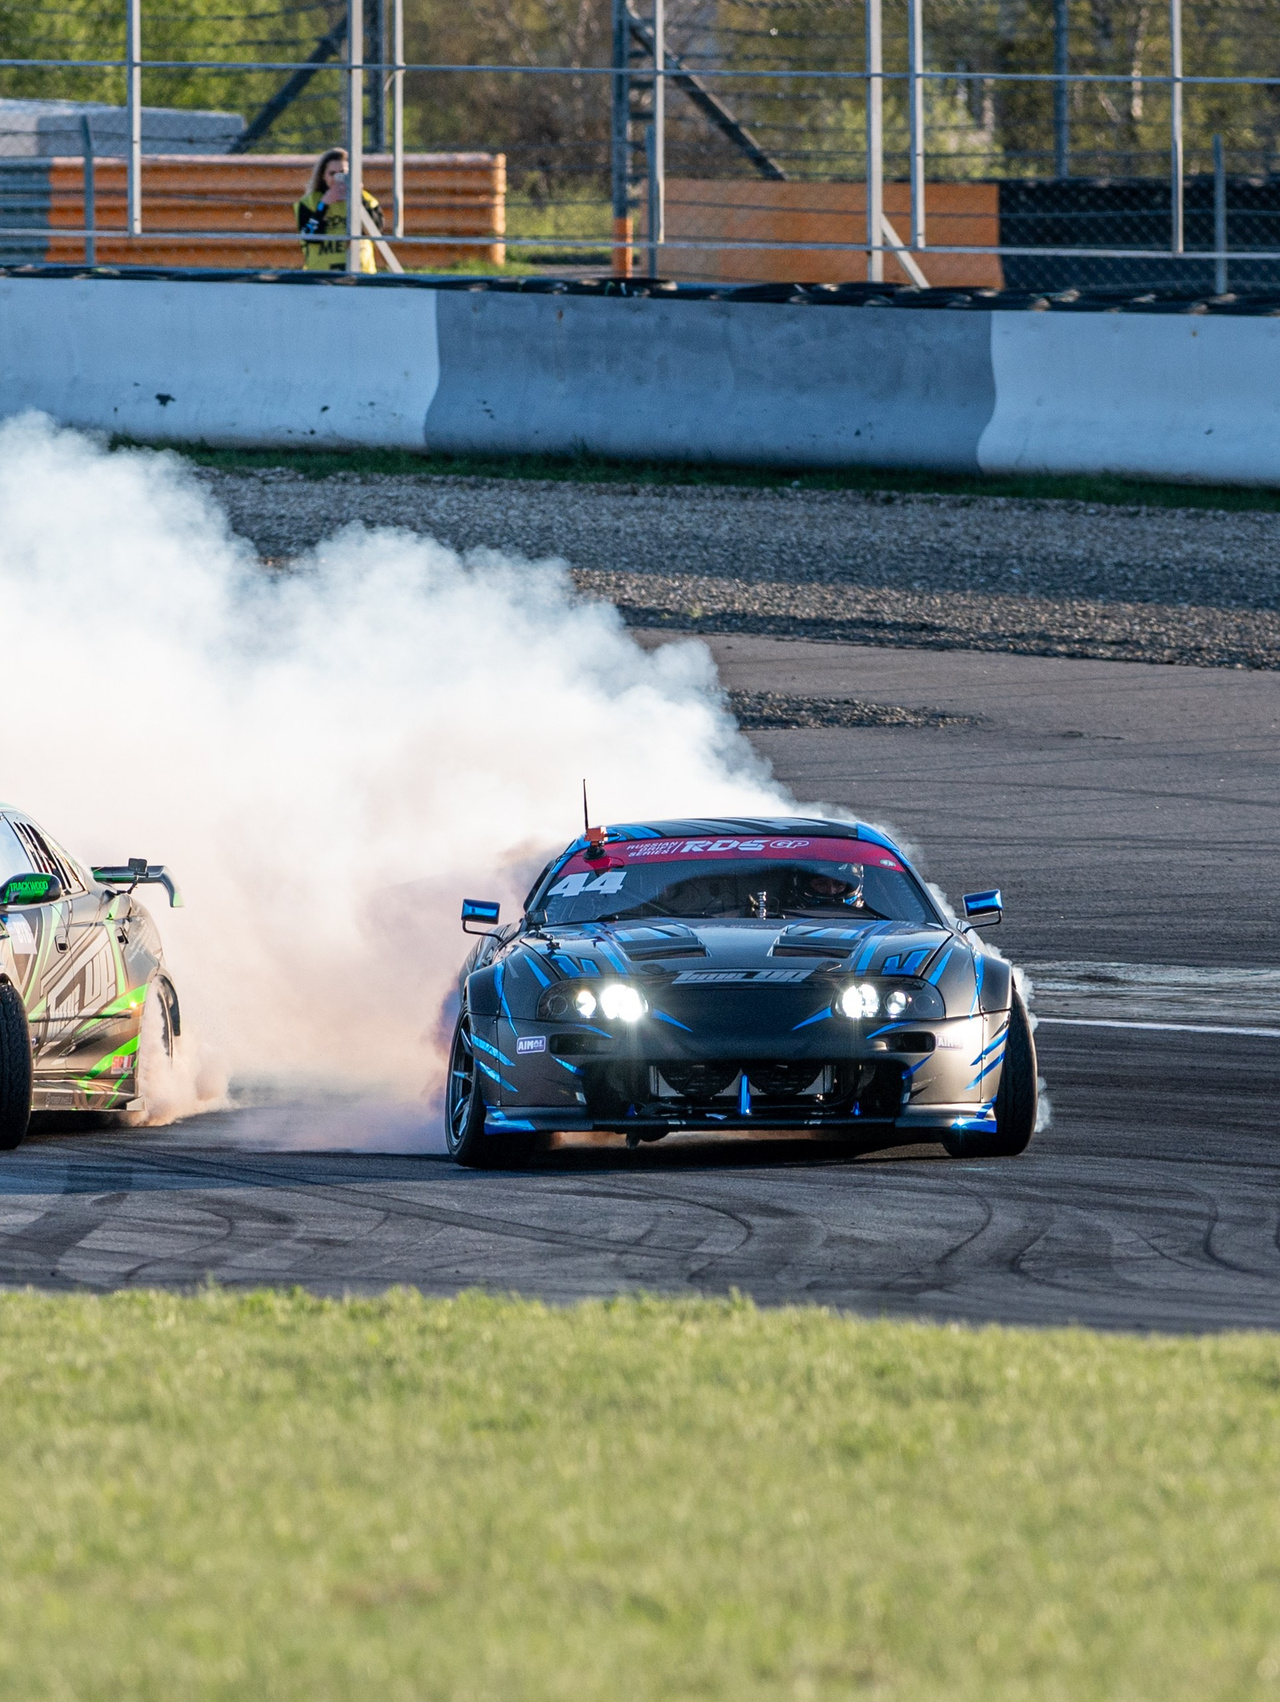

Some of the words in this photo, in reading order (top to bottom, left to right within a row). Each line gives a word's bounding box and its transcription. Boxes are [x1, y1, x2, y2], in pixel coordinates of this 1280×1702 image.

[626, 841, 679, 850] RUSSIAN
[637, 846, 675, 854] DRIFT
[680, 839, 770, 853] RDS
[770, 840, 810, 849] GP
[628, 849, 671, 858] SERIES
[547, 871, 627, 897] 44
[518, 1039, 544, 1051] AIMOL
